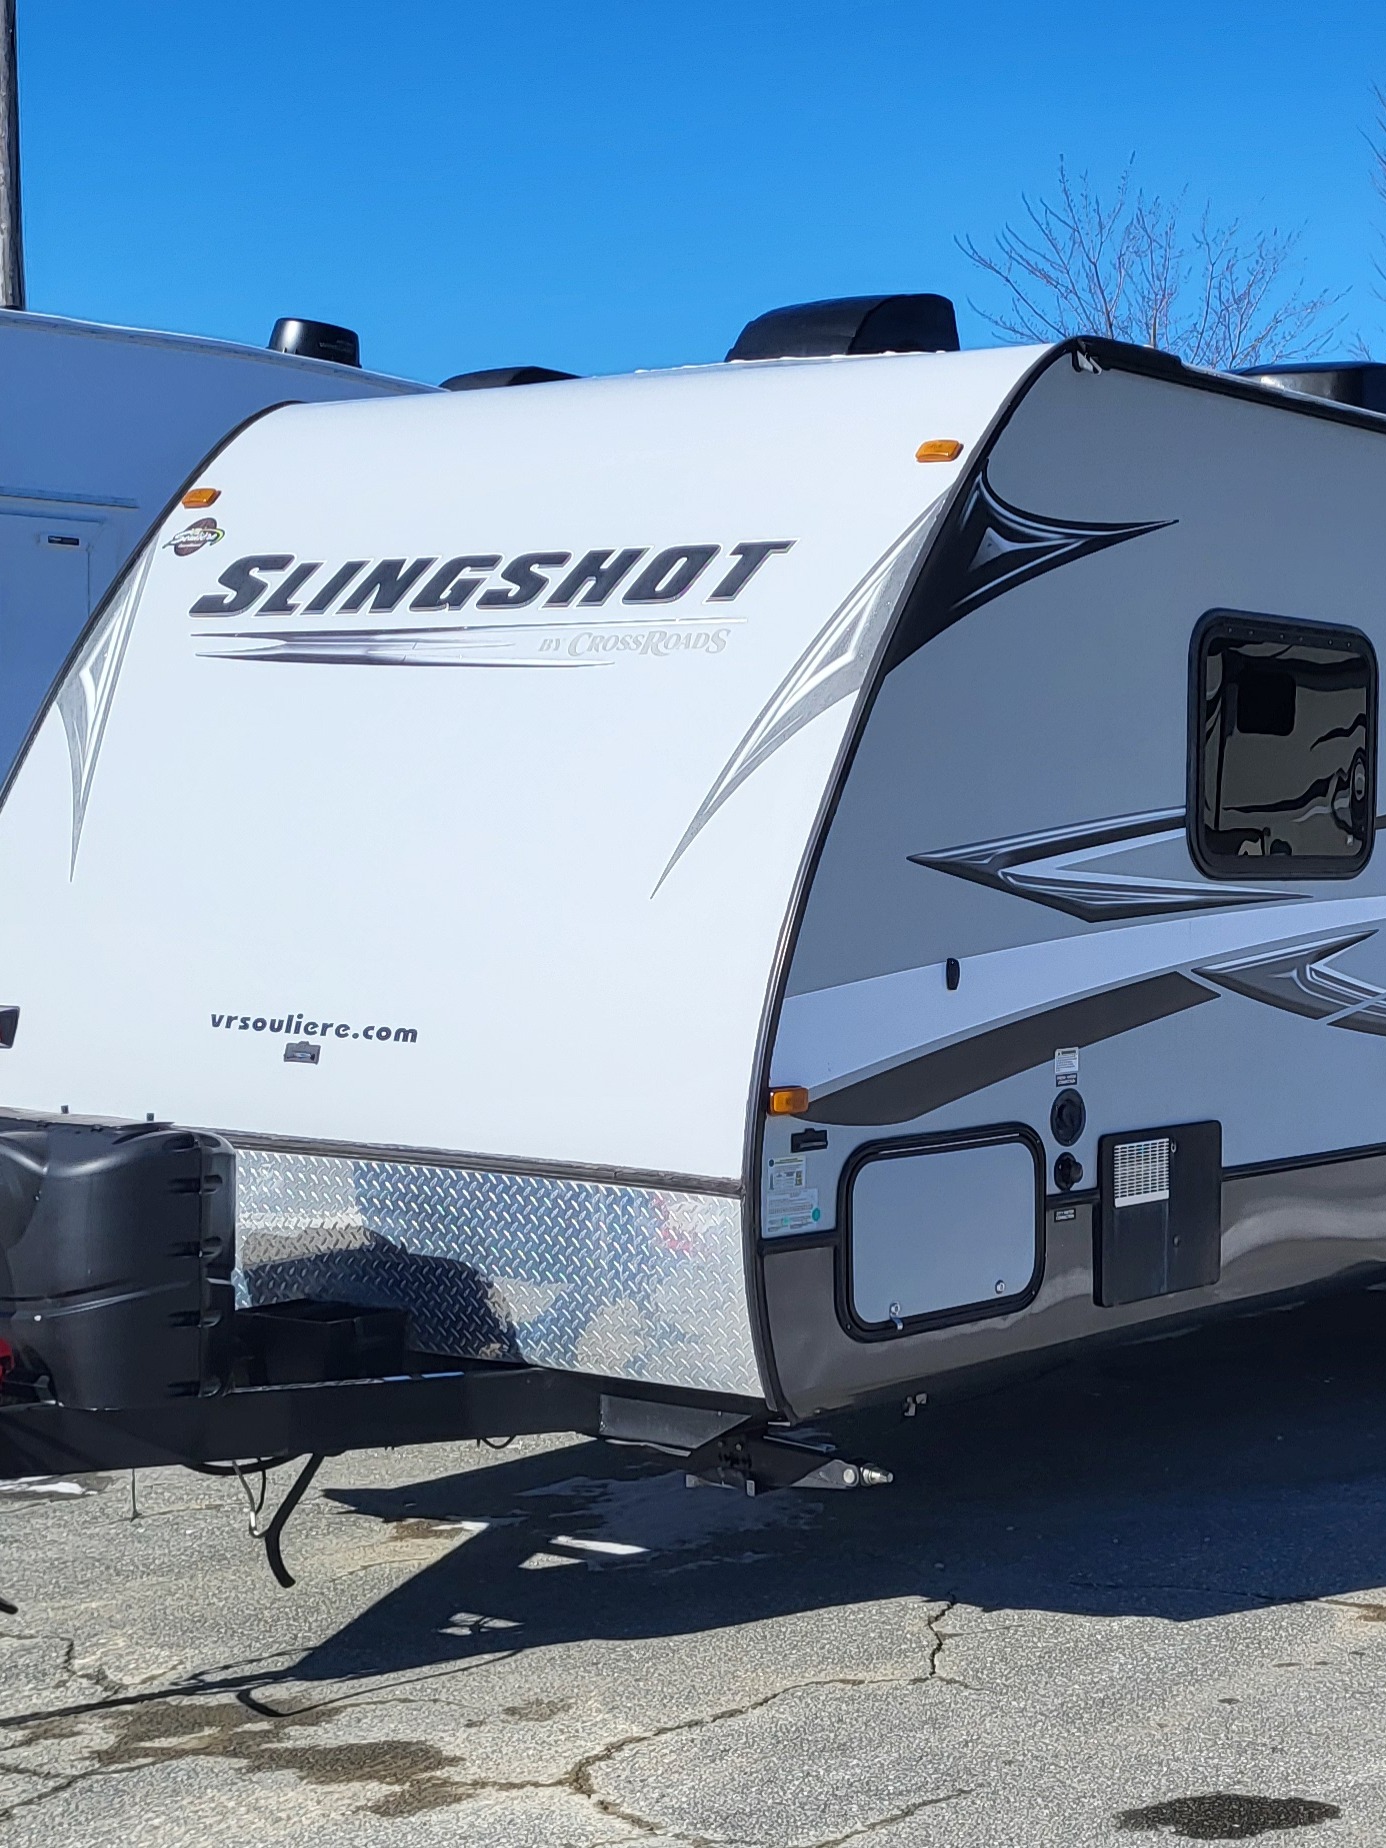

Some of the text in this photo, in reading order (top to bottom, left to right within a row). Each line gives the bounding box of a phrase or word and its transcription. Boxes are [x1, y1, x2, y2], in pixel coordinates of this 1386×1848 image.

[188, 540, 797, 618] SLINGSHOT
[567, 628, 731, 657] CROSSROADS
[210, 1013, 419, 1043] vrsouliere.com
